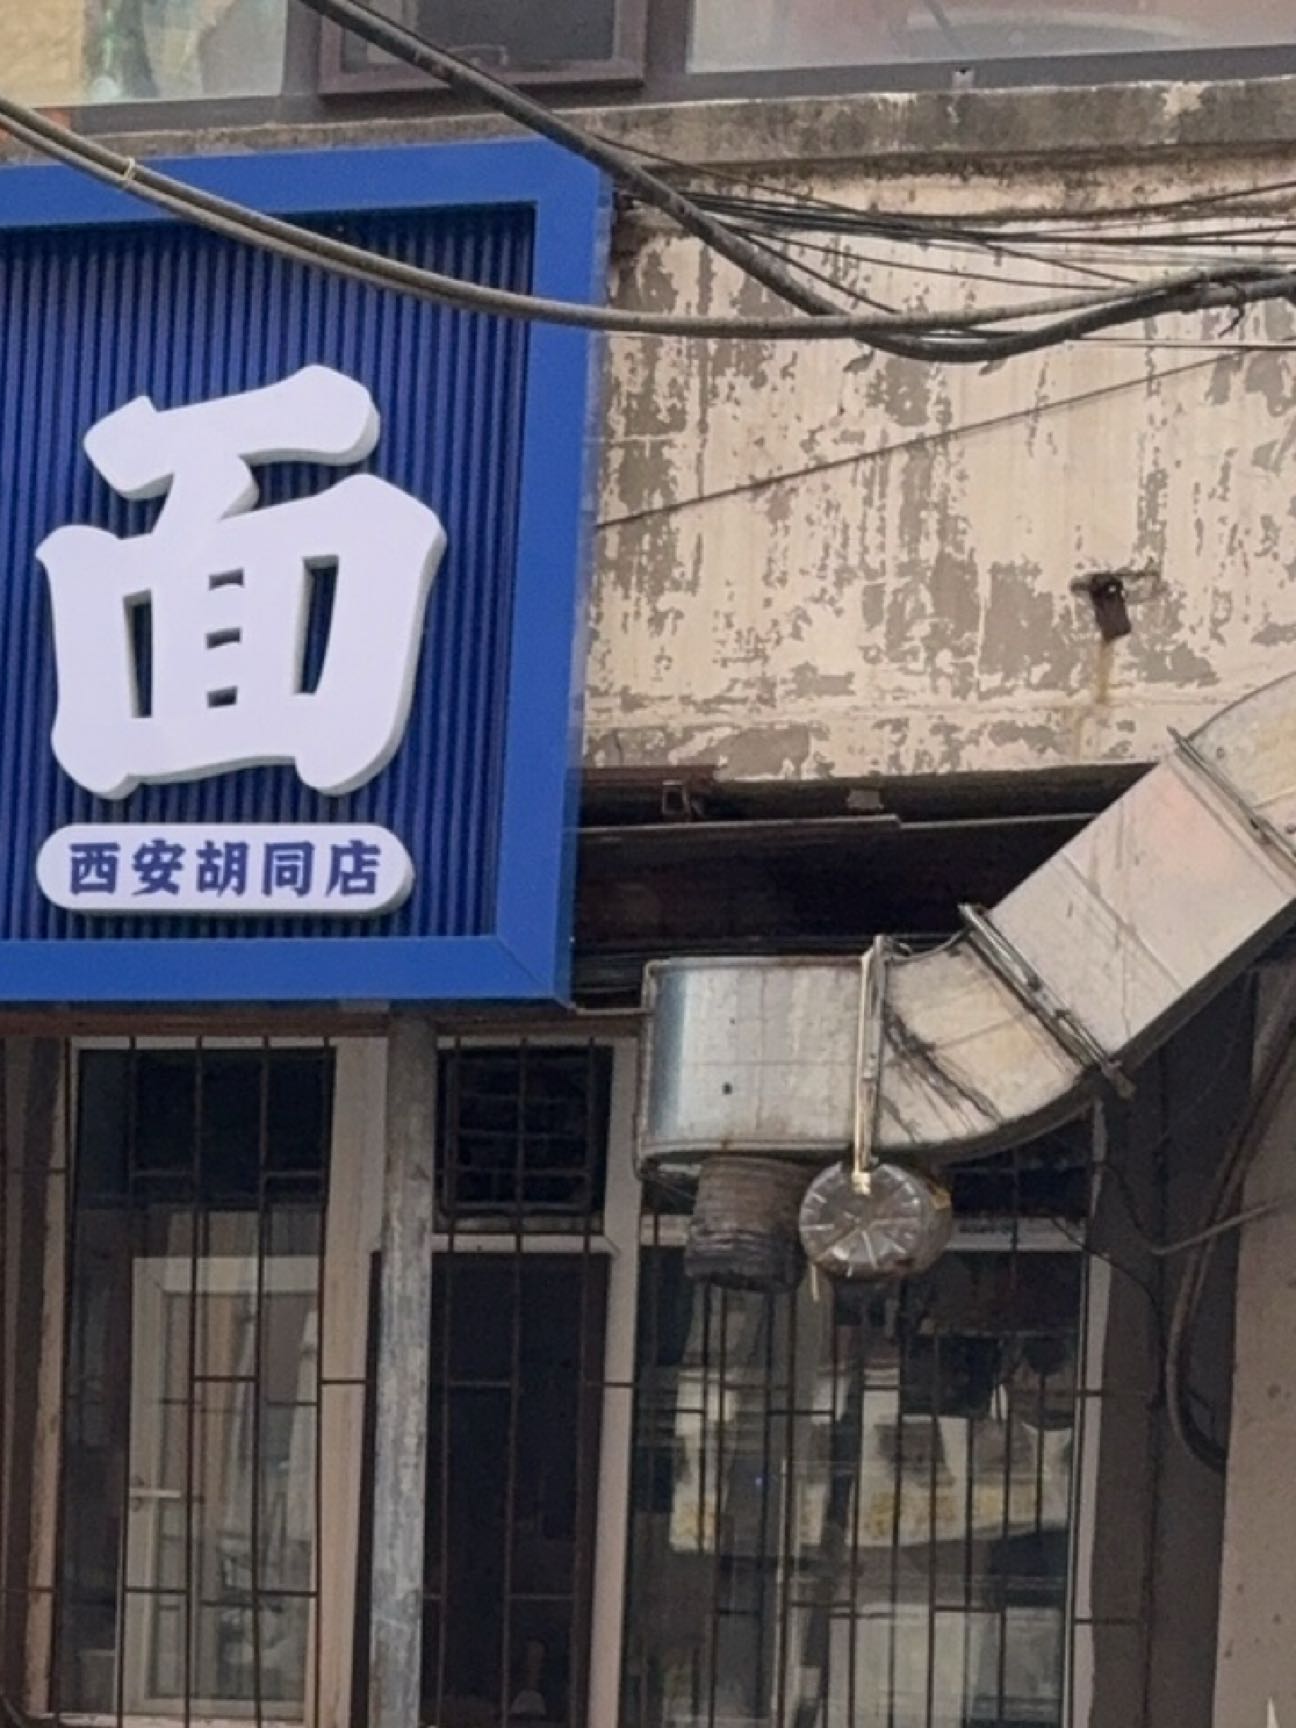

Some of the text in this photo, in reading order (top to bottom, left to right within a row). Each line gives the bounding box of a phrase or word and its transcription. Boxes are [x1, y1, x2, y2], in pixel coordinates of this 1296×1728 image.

[68, 838, 382, 899] 西安胡同店
